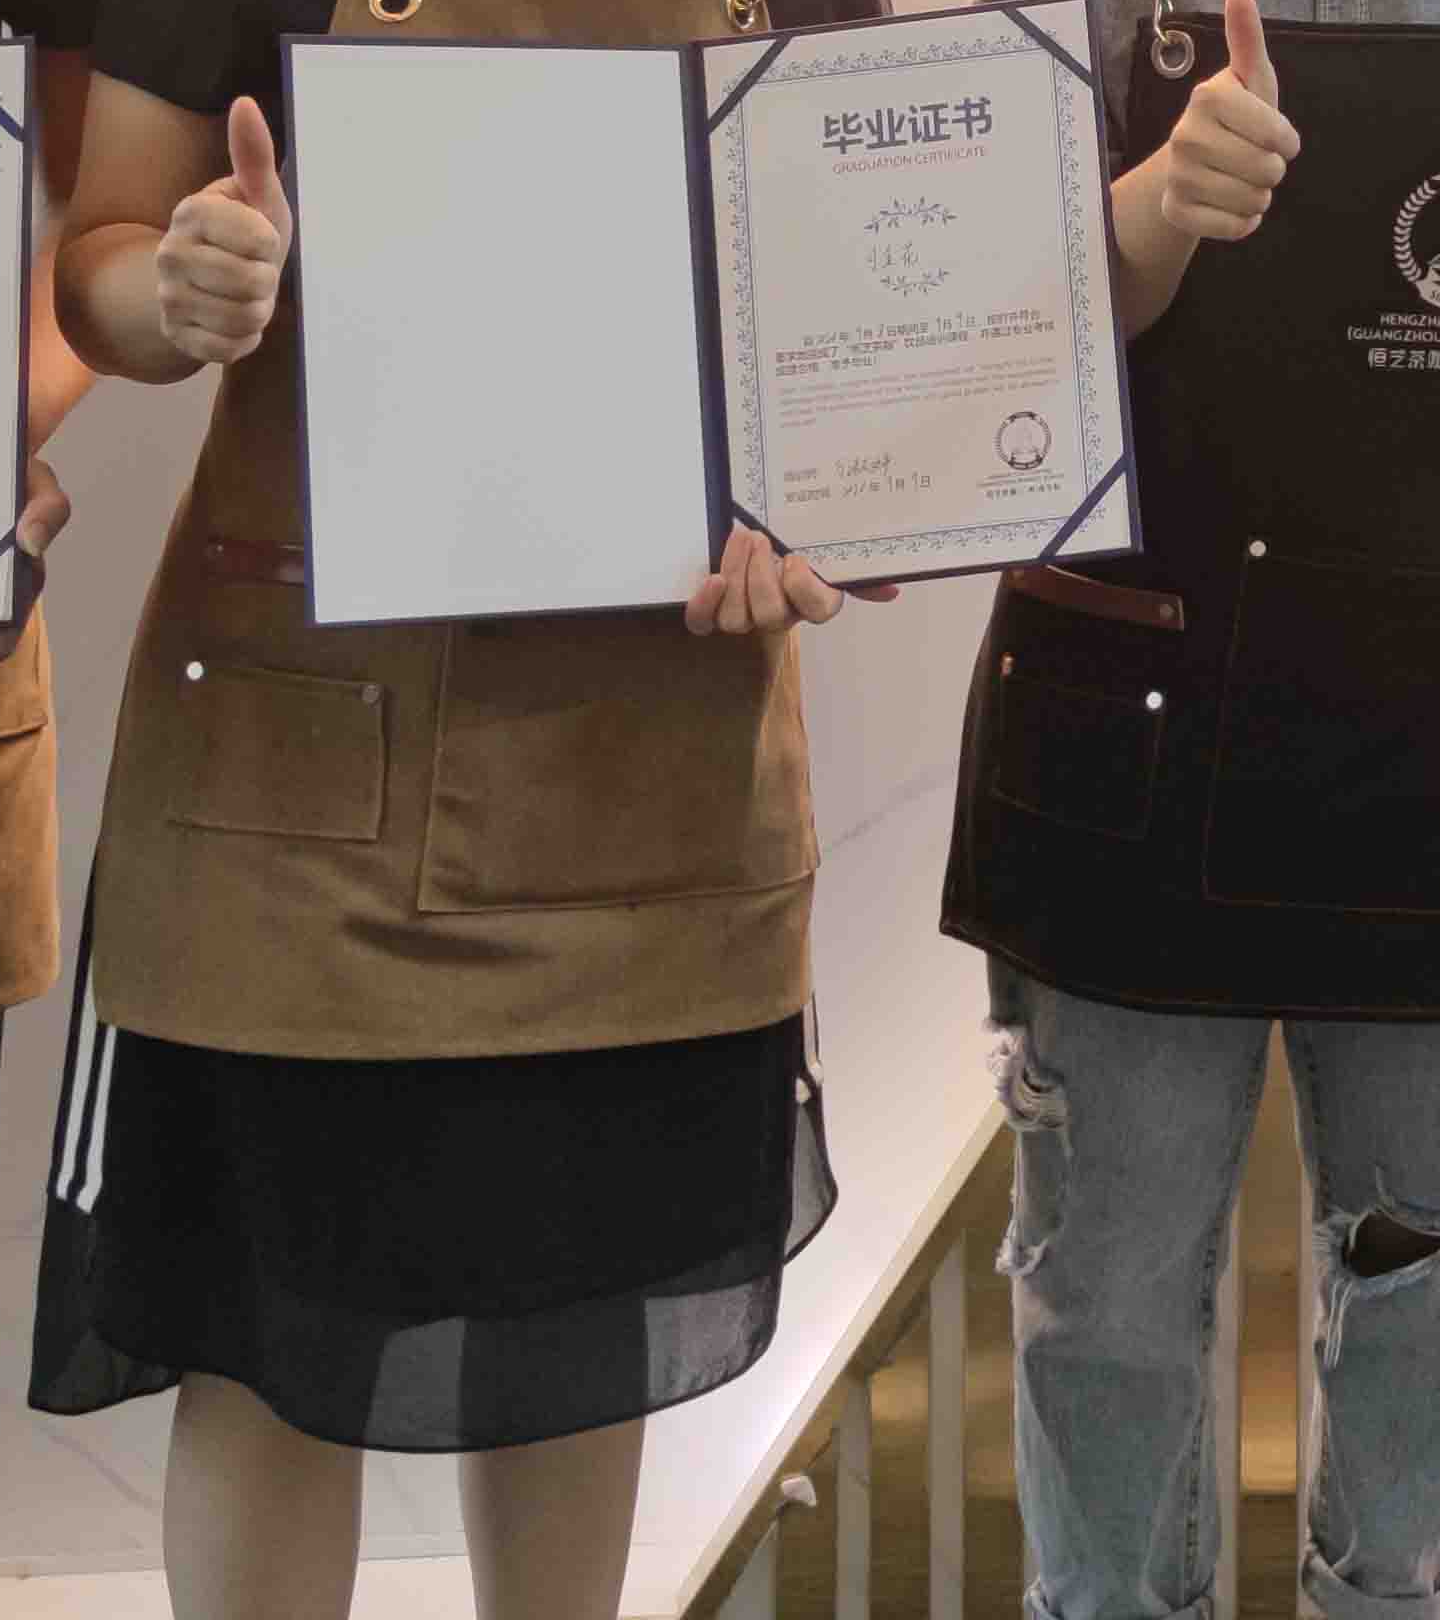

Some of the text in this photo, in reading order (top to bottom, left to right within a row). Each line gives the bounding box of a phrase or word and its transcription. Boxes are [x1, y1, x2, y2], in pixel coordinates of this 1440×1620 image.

[822, 96, 992, 155] 毕业证书
[1379, 314, 1440, 327] HENGZHI
